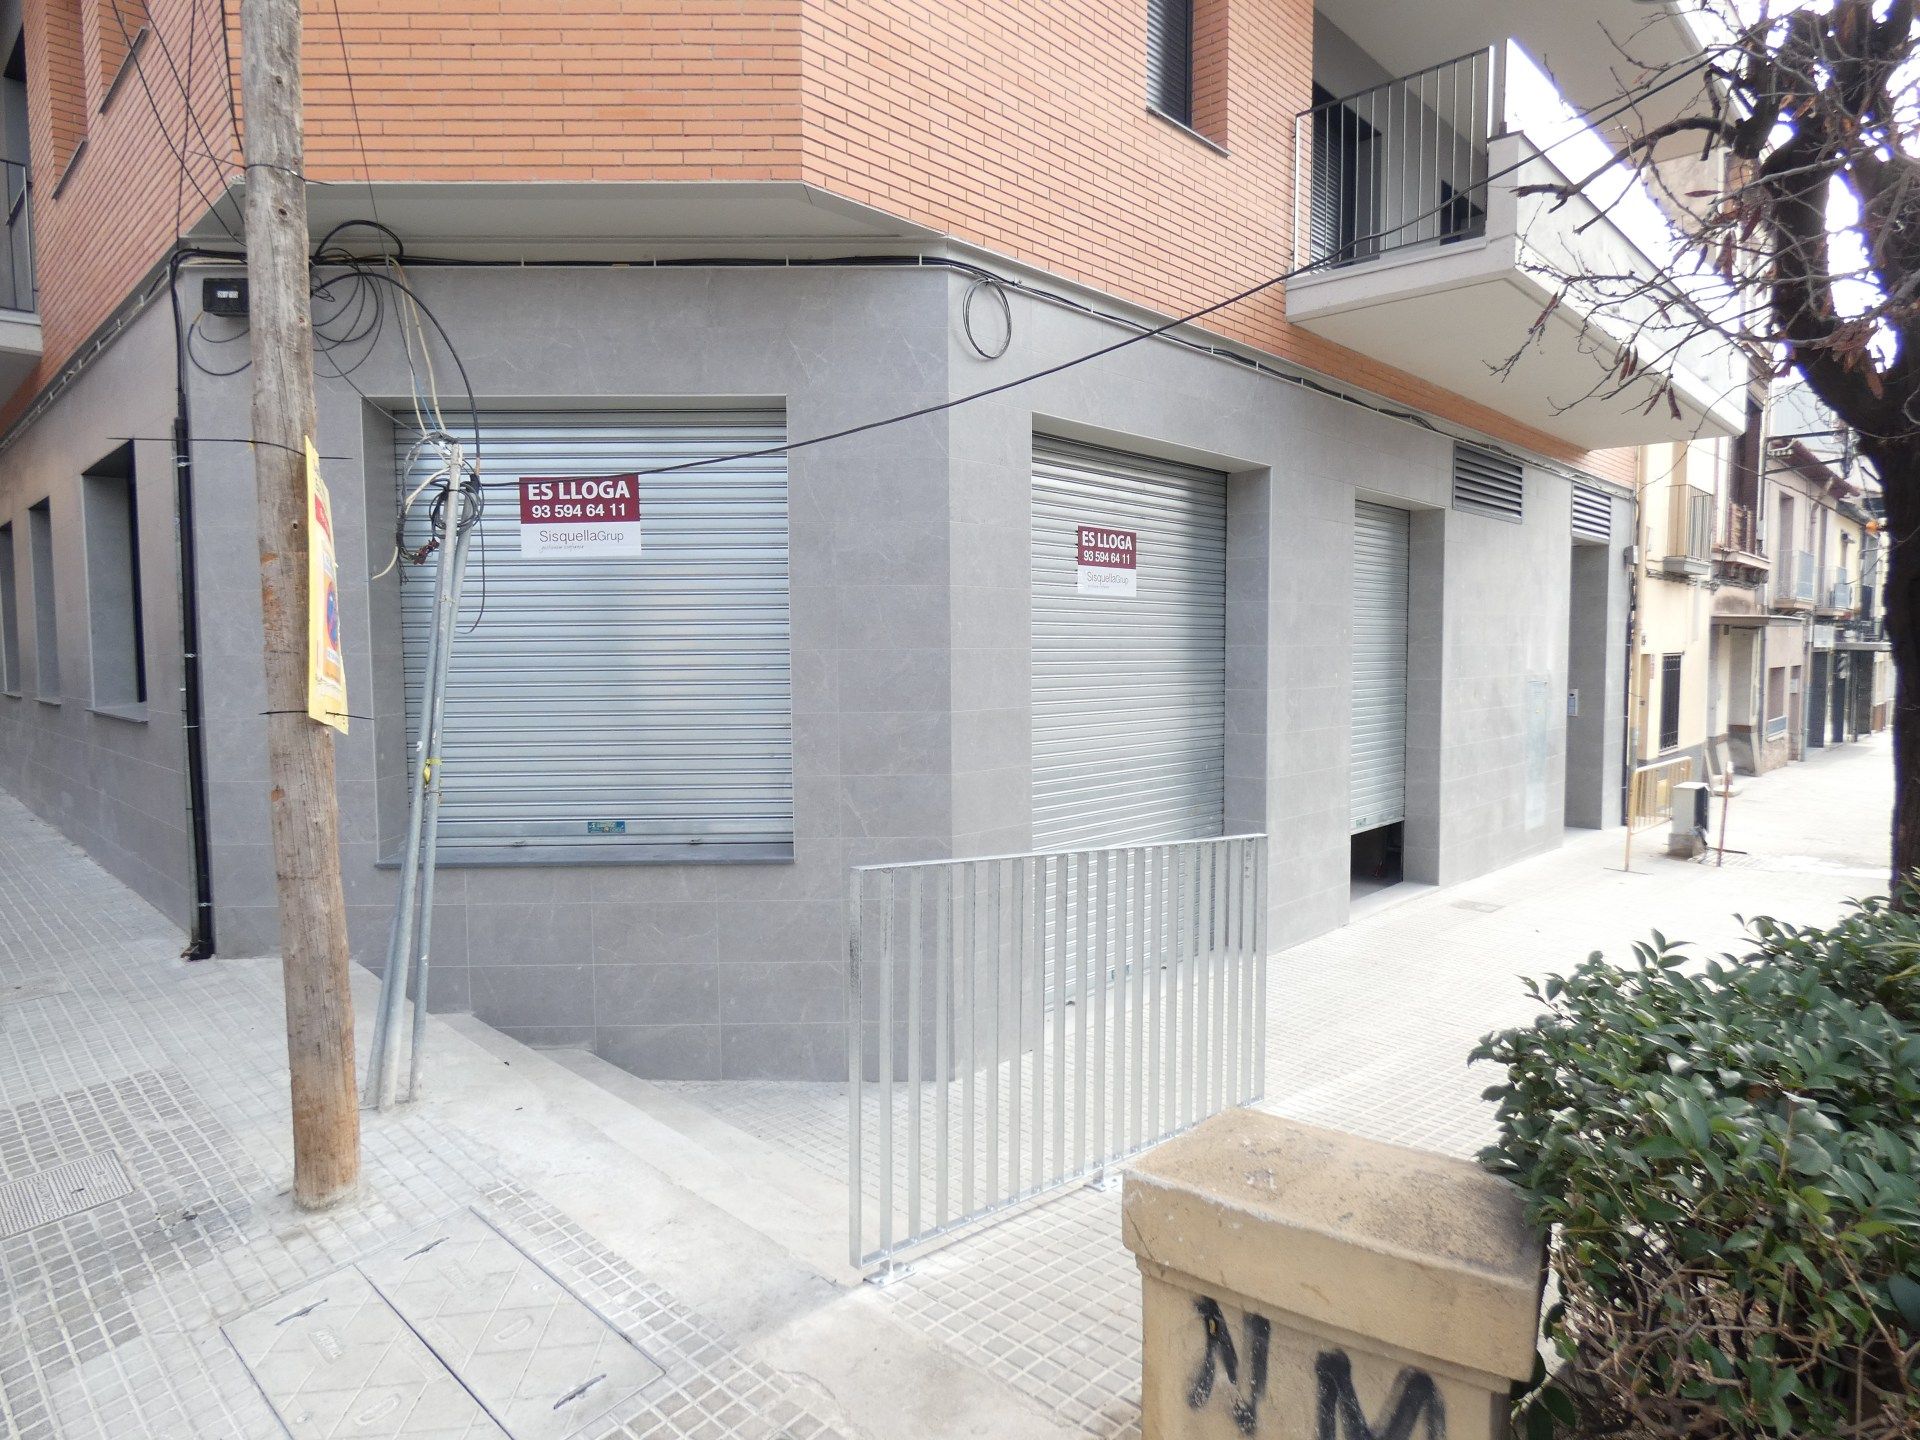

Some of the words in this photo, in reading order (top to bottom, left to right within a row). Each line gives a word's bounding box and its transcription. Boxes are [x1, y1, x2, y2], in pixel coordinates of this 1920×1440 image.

[528, 483, 553, 500] ES
[558, 481, 630, 500] LLOGA
[532, 504, 551, 518] 93
[555, 503, 582, 518] 594
[586, 503, 605, 517] 64
[610, 503, 626, 516] 11
[539, 530, 624, 546] SisquellaGrup
[1082, 531, 1095, 546] ES
[1098, 533, 1132, 550] LLOGA
[1084, 550, 1093, 561] 93
[1095, 551, 1109, 562] 594
[1111, 553, 1119, 563] 64
[1122, 554, 1129, 564] 11
